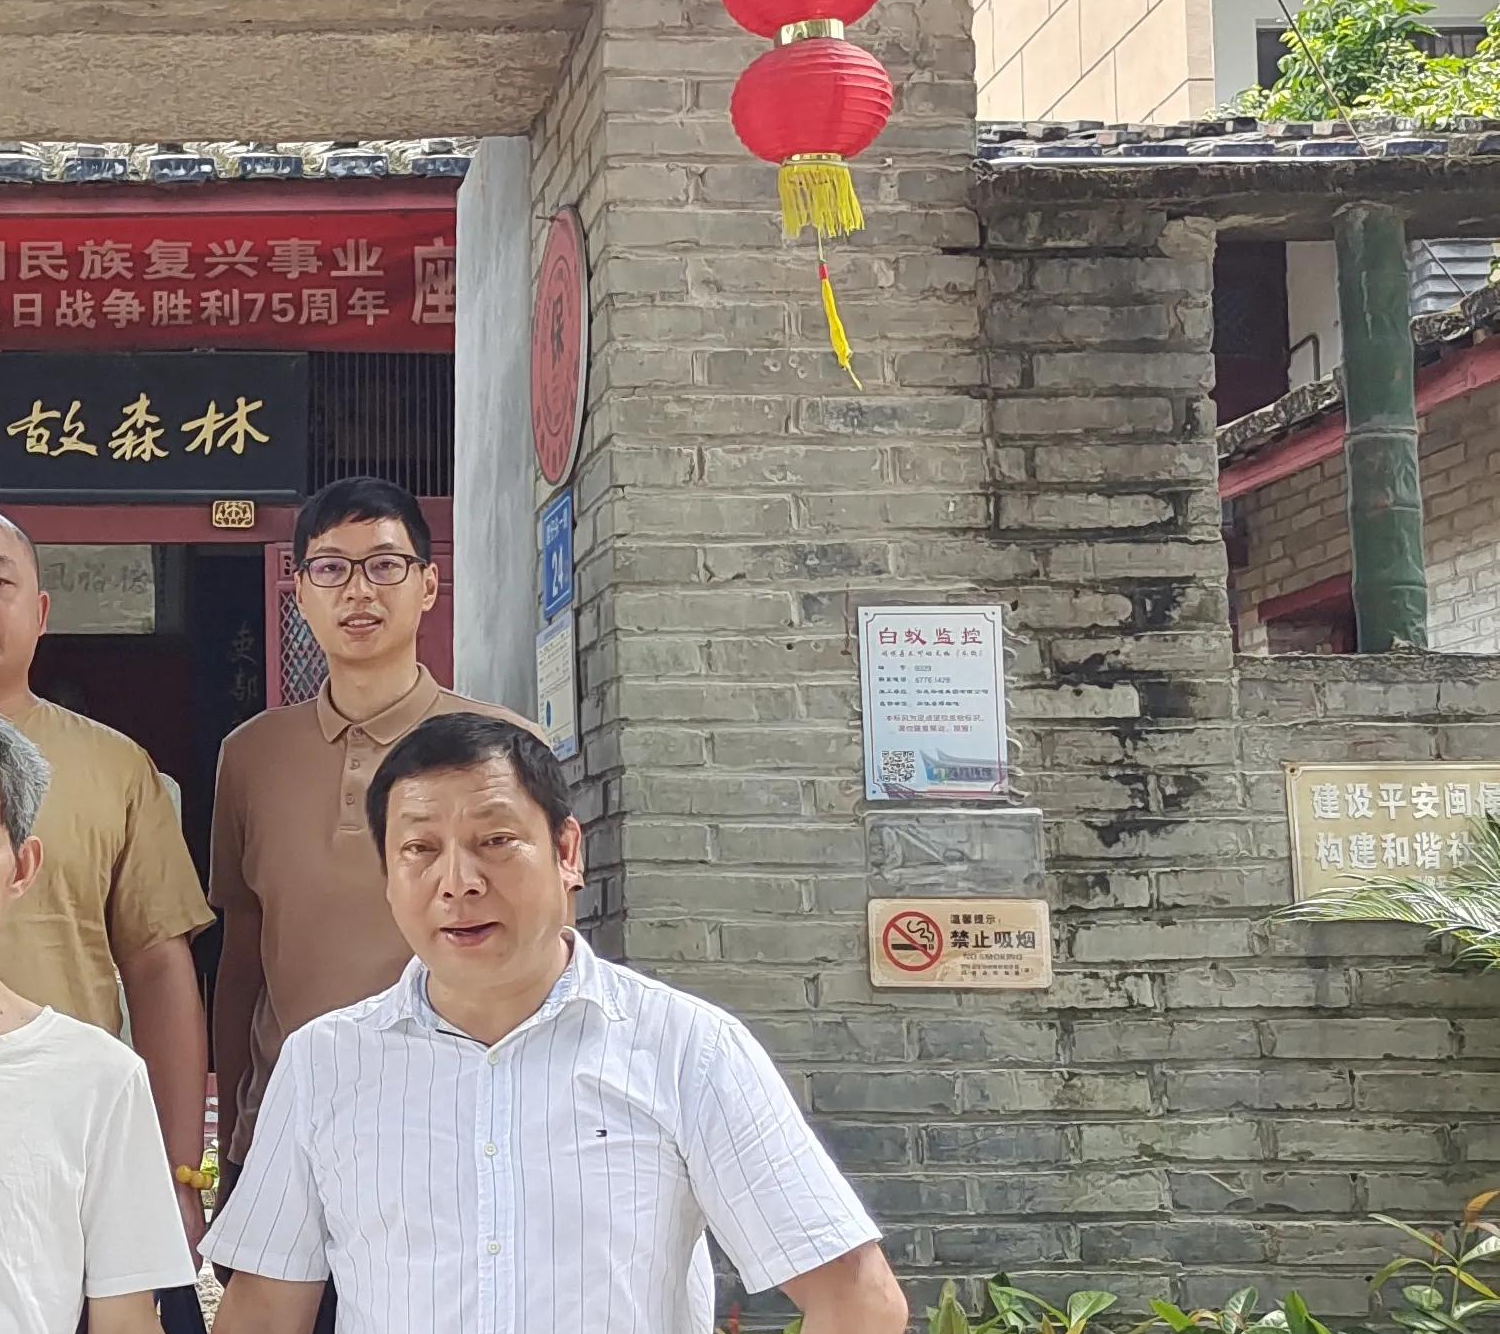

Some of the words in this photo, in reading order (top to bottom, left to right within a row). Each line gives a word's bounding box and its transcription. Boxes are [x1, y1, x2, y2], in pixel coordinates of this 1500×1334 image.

[551, 546, 564, 598] 24
[879, 627, 983, 645] 白蚁监控
[950, 930, 1035, 949] 禁止吸烟
